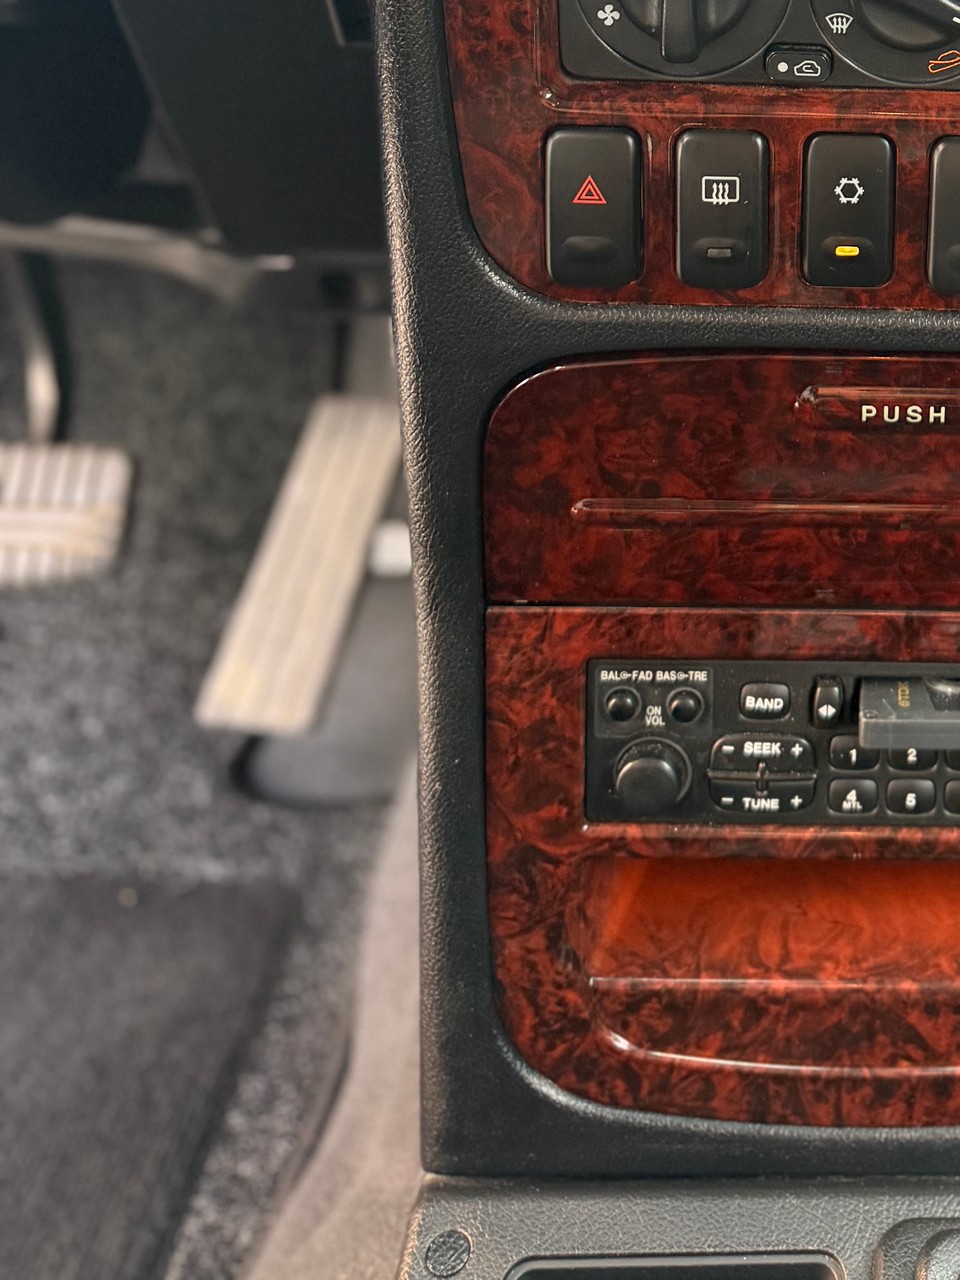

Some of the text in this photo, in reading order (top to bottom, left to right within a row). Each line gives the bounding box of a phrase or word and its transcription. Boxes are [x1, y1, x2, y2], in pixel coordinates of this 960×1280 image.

[861, 404, 946, 424] PUSH
[646, 705, 662, 716] ON
[745, 696, 784, 712] BAND
[645, 716, 665, 726] VOL
[743, 741, 782, 759] SEEK
[849, 748, 857, 766] 1
[906, 748, 917, 765] 2
[846, 789, 857, 802] 4
[905, 793, 917, 810] 5
[742, 797, 780, 813] TUNE
